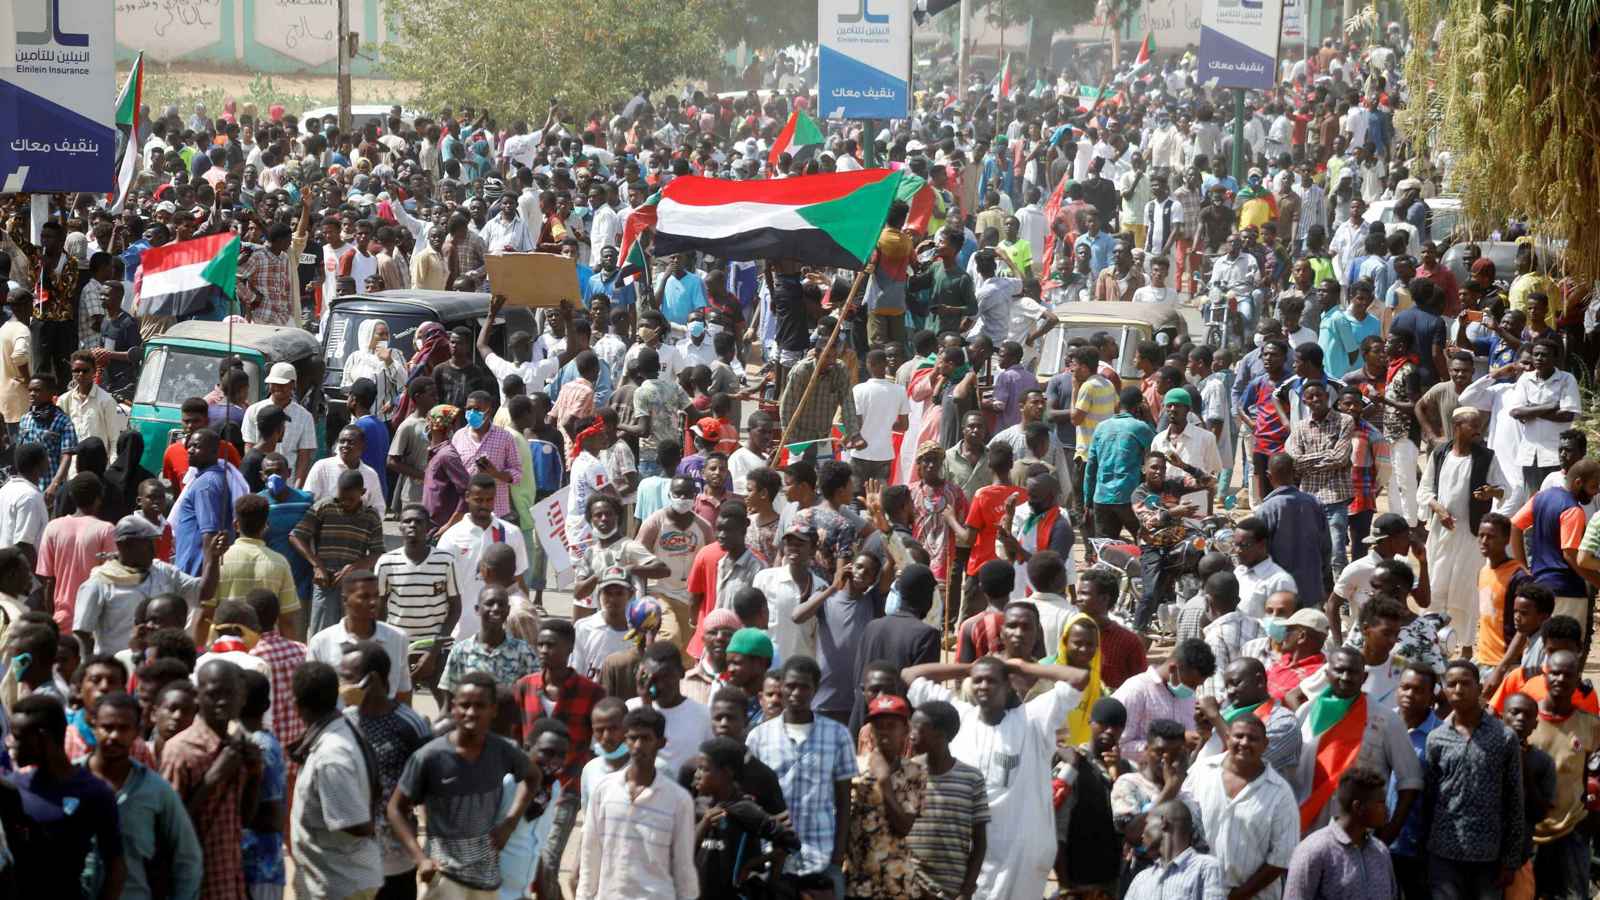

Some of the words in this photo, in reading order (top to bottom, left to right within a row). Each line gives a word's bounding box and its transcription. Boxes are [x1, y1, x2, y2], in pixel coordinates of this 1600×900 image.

[57, 51, 89, 64] النيلين
[16, 64, 47, 74] Elnilein
[49, 66, 89, 75] Insurance
[831, 87, 861, 98] معاك
[862, 86, 896, 100] بنقيف
[10, 139, 51, 152] معاك
[54, 138, 99, 156] بنقيف
